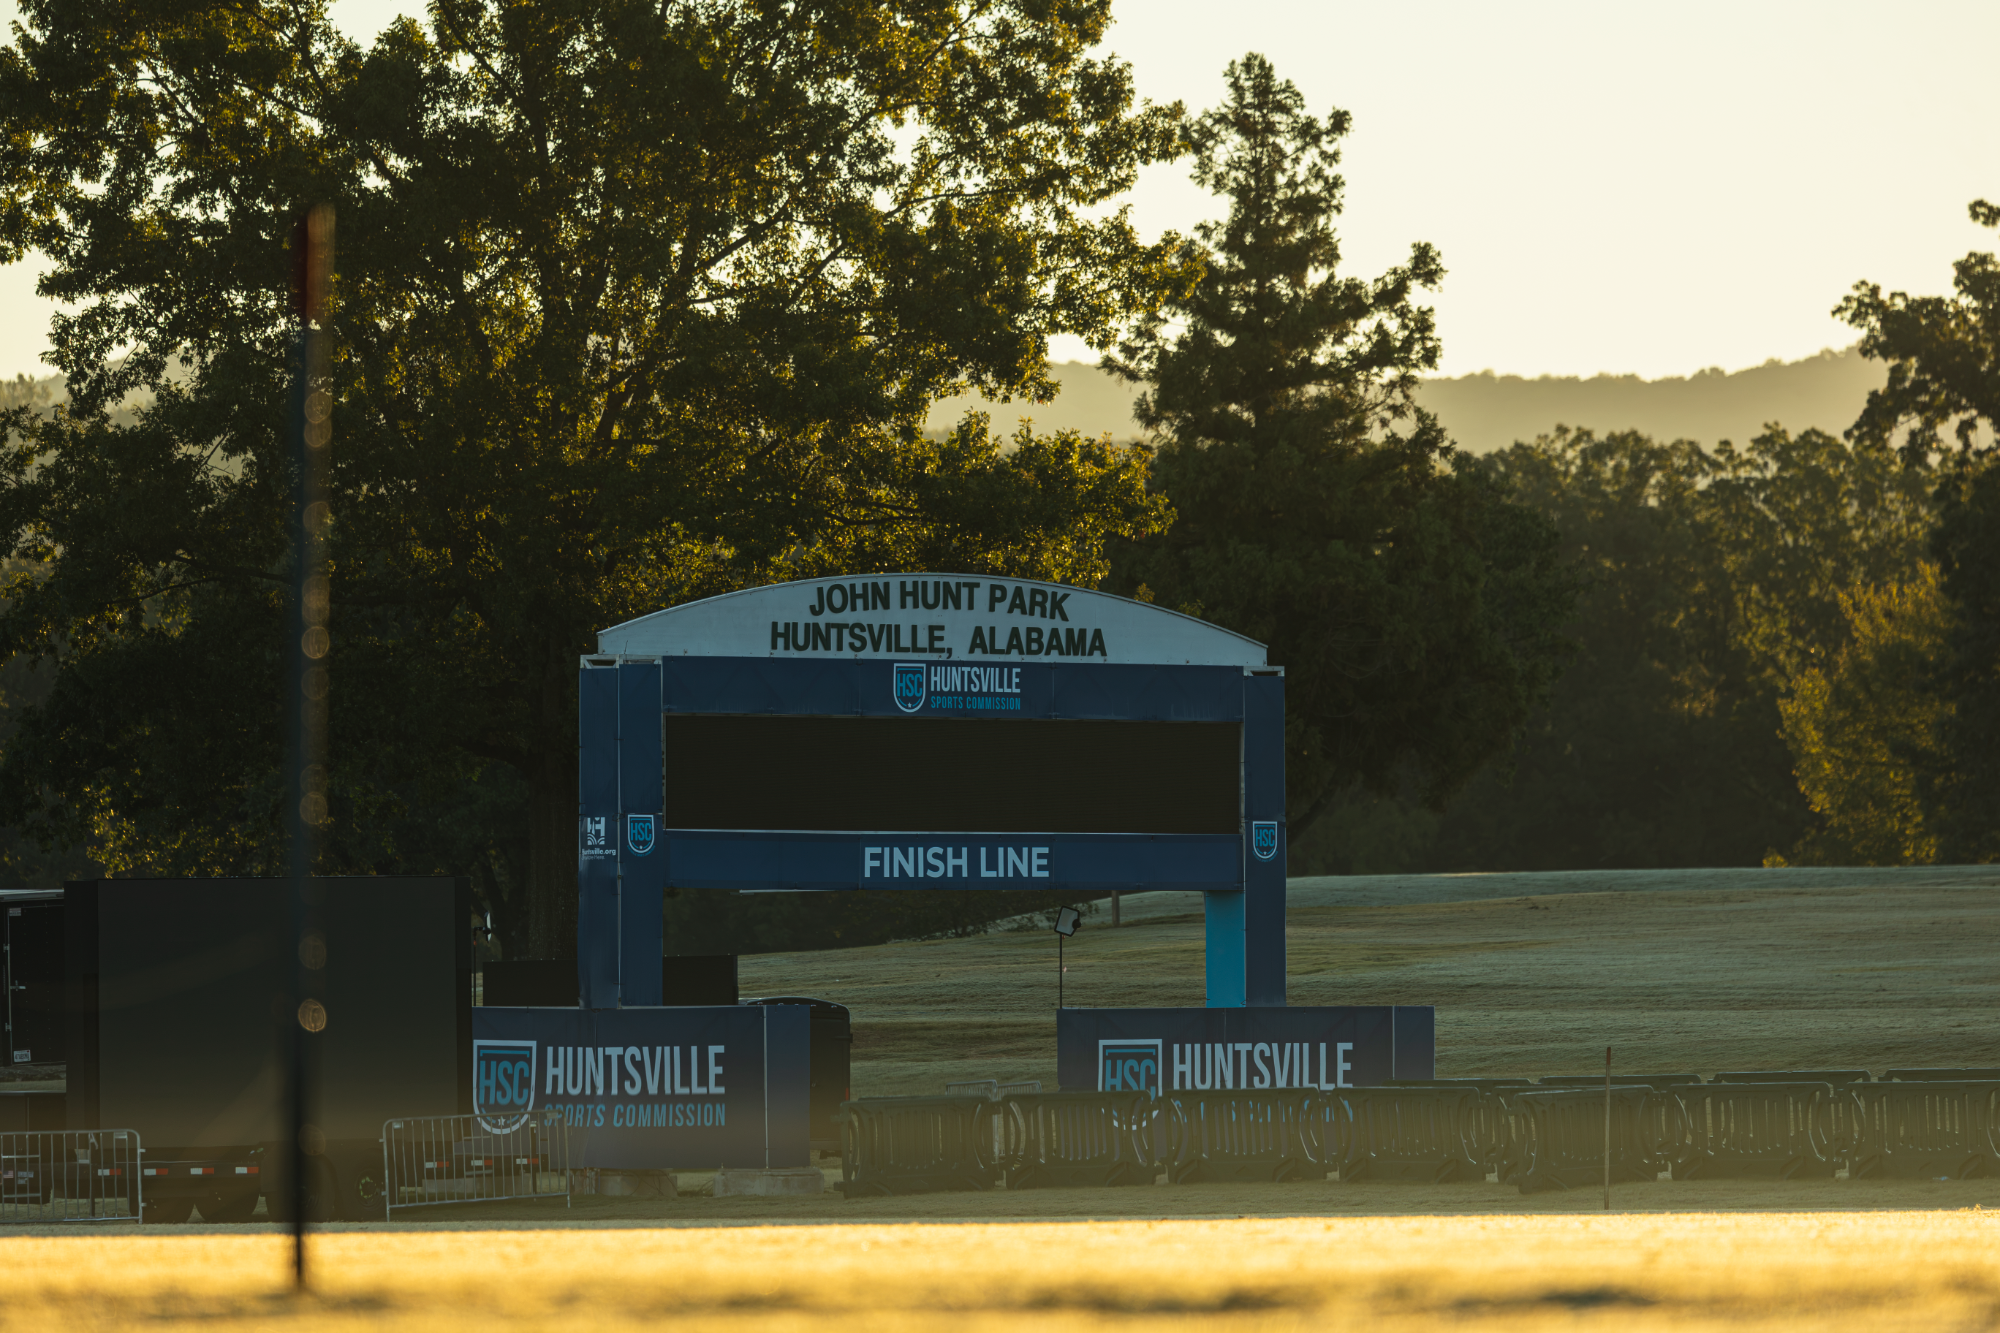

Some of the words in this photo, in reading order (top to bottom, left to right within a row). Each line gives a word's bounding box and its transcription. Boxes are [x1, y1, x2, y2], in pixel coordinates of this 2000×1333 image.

[809, 581, 890, 616] JOHN
[899, 580, 980, 610] HUNT
[988, 584, 1071, 622] PARK
[771, 621, 953, 659] HUNTSVILLE,
[968, 625, 1108, 657] ALABAMA
[897, 673, 923, 697] HSC
[930, 666, 1021, 693] HUNTSVILLE
[930, 695, 964, 709] SPORTS
[966, 696, 1021, 710] COMMISSION
[630, 822, 652, 841] HSC
[1255, 828, 1275, 847] HSC
[864, 846, 968, 878] FINISH
[980, 846, 1050, 878] LINE
[478, 1060, 530, 1105] HSC
[545, 1045, 726, 1096] HUNTSVILLE
[1105, 1059, 1156, 1101] HSC
[1173, 1042, 1354, 1091] HUNTSVILLE
[613, 1103, 726, 1128] COMMISSION
